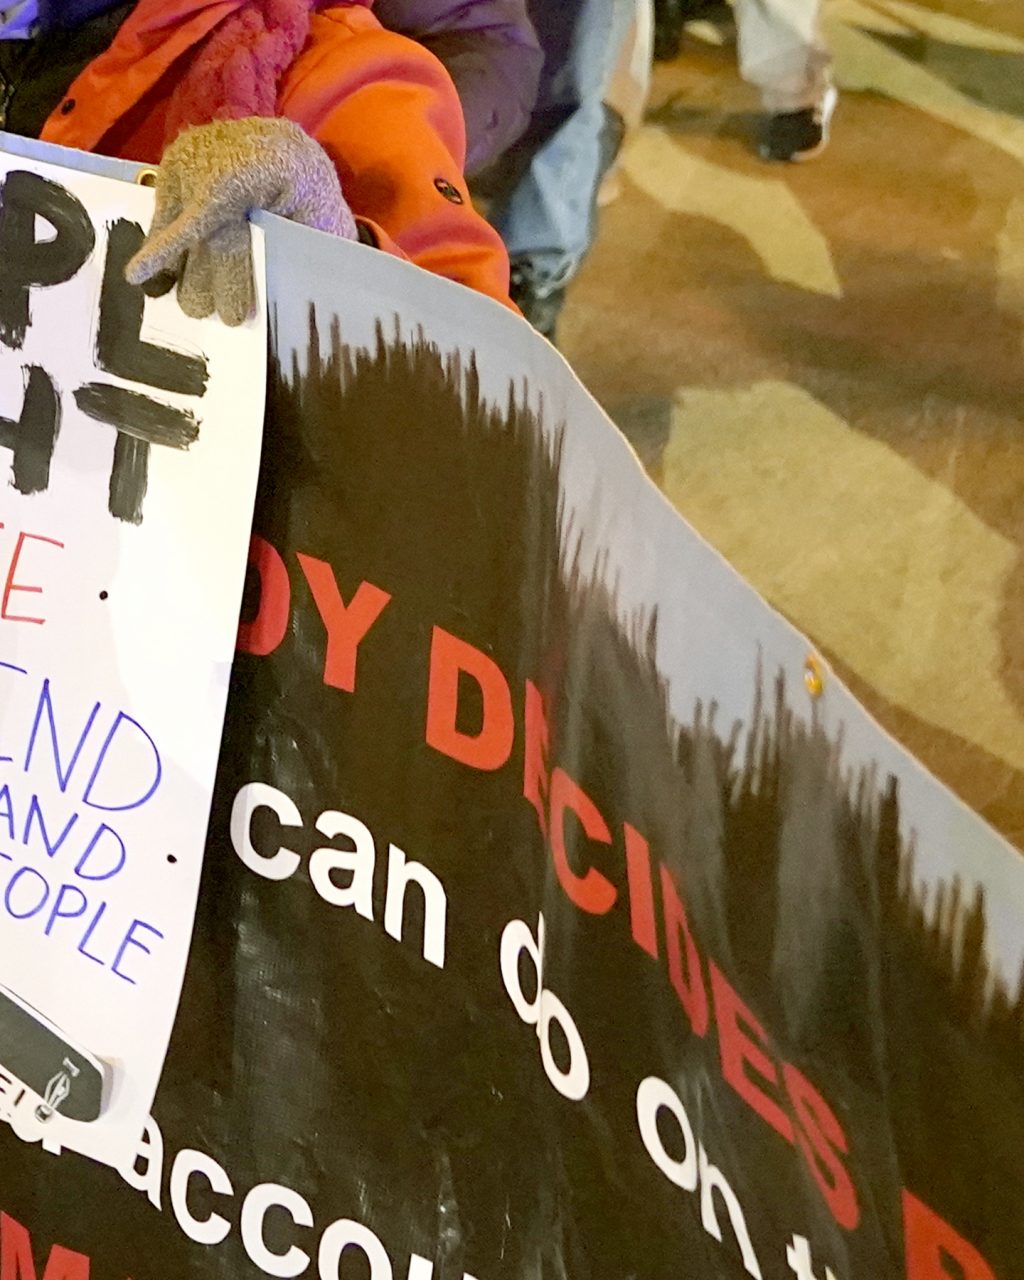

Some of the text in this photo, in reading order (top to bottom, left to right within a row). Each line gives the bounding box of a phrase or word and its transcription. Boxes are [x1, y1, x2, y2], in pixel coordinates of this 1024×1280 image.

[230, 782, 447, 969] can
[500, 912, 591, 1101] do
[637, 1076, 763, 1280] on
